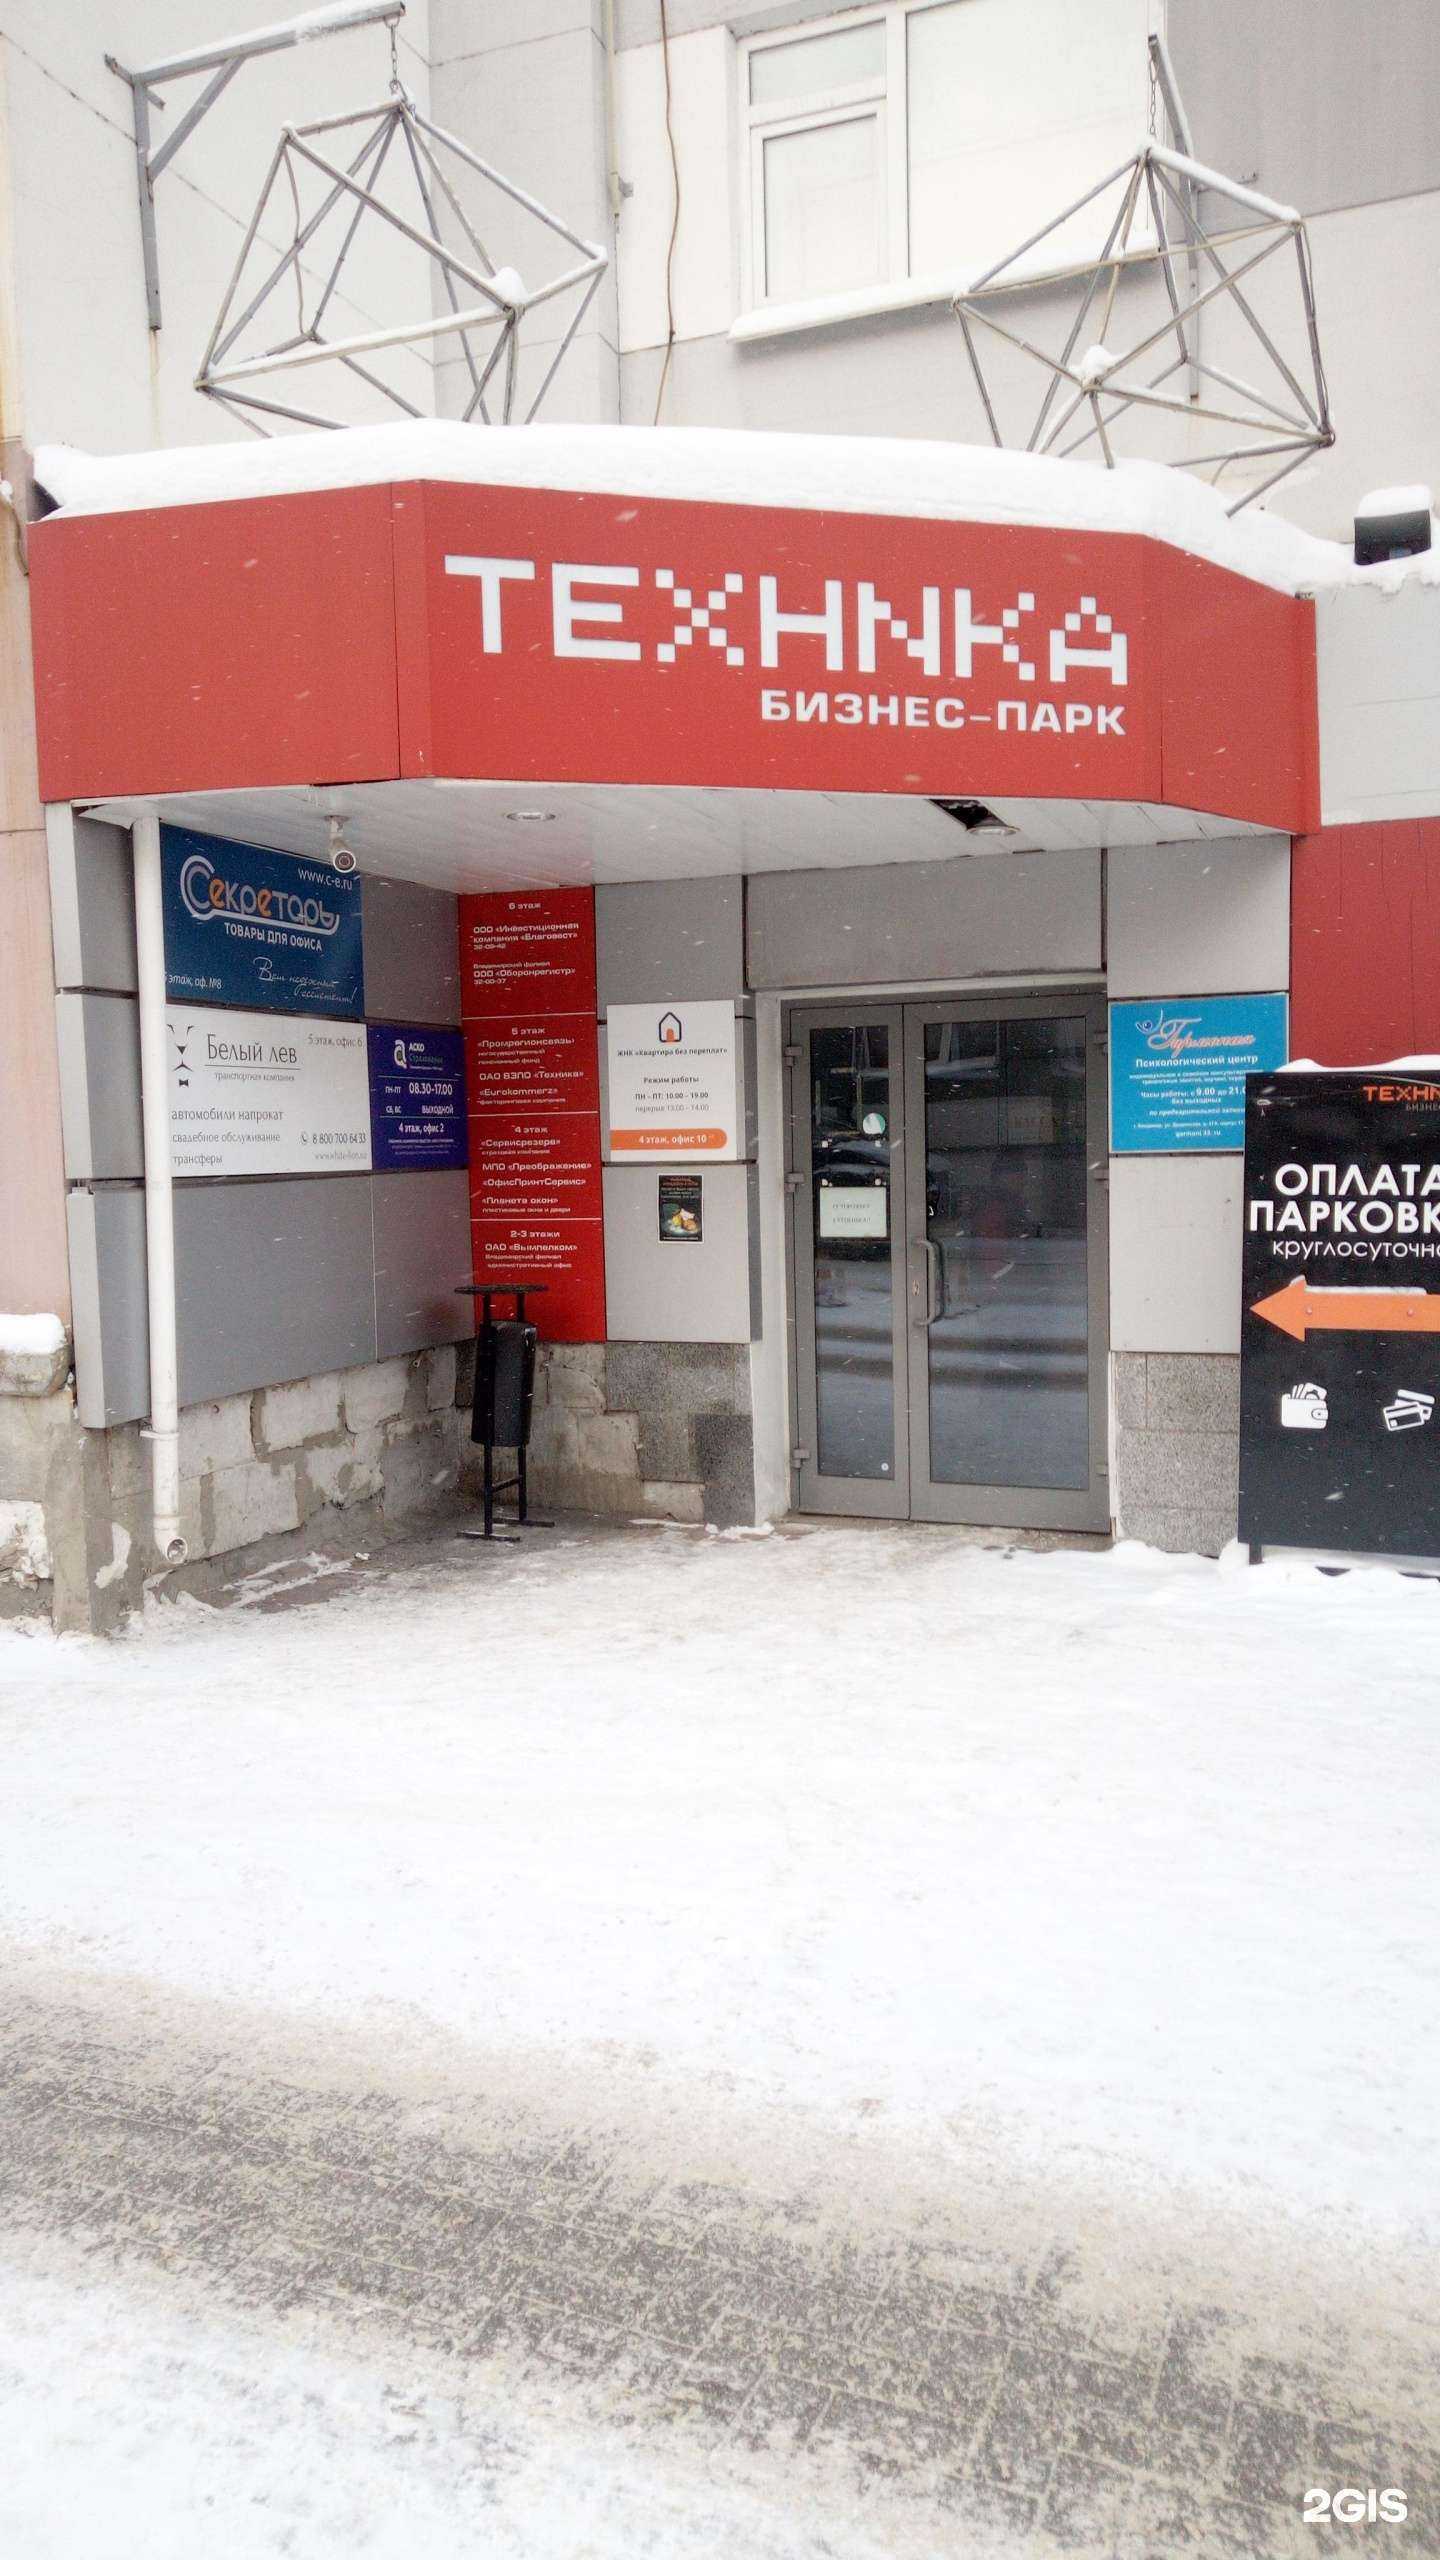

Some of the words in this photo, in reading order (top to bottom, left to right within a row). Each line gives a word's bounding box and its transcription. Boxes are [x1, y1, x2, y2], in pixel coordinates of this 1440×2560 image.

[761, 689, 1126, 735] БИЗНЕС-ПАРК
[297, 868, 353, 891] www.c-e.ru
[180, 855, 339, 935] Секретарь
[224, 922, 265, 941] ТОВАРЫ
[267, 930, 288, 946] ДЛЯ
[290, 935, 322, 951] ОФИСА
[474, 926, 493, 934] ООО
[474, 970, 494, 978] ООО
[308, 1034, 314, 1045] 5
[336, 1036, 356, 1048] офис
[207, 1033, 263, 1063] Белый
[269, 1046, 298, 1064] лев
[1136, 1057, 1225, 1068] Психологический
[1228, 1055, 1259, 1065] центр
[480, 1072, 501, 1080] ОАО
[409, 1082, 453, 1096] 08.30-17.00
[171, 1108, 236, 1121] автомобили
[239, 1110, 284, 1125] напрокат
[172, 1131, 219, 1143] свадебное
[222, 1132, 281, 1145] обслуживание
[672, 1135, 695, 1145] офис
[173, 1153, 223, 1166] трансферы
[483, 1163, 506, 1171] МПО
[485, 1243, 507, 1251] ОАО
[1273, 1240, 1440, 1262] круглосуточн
